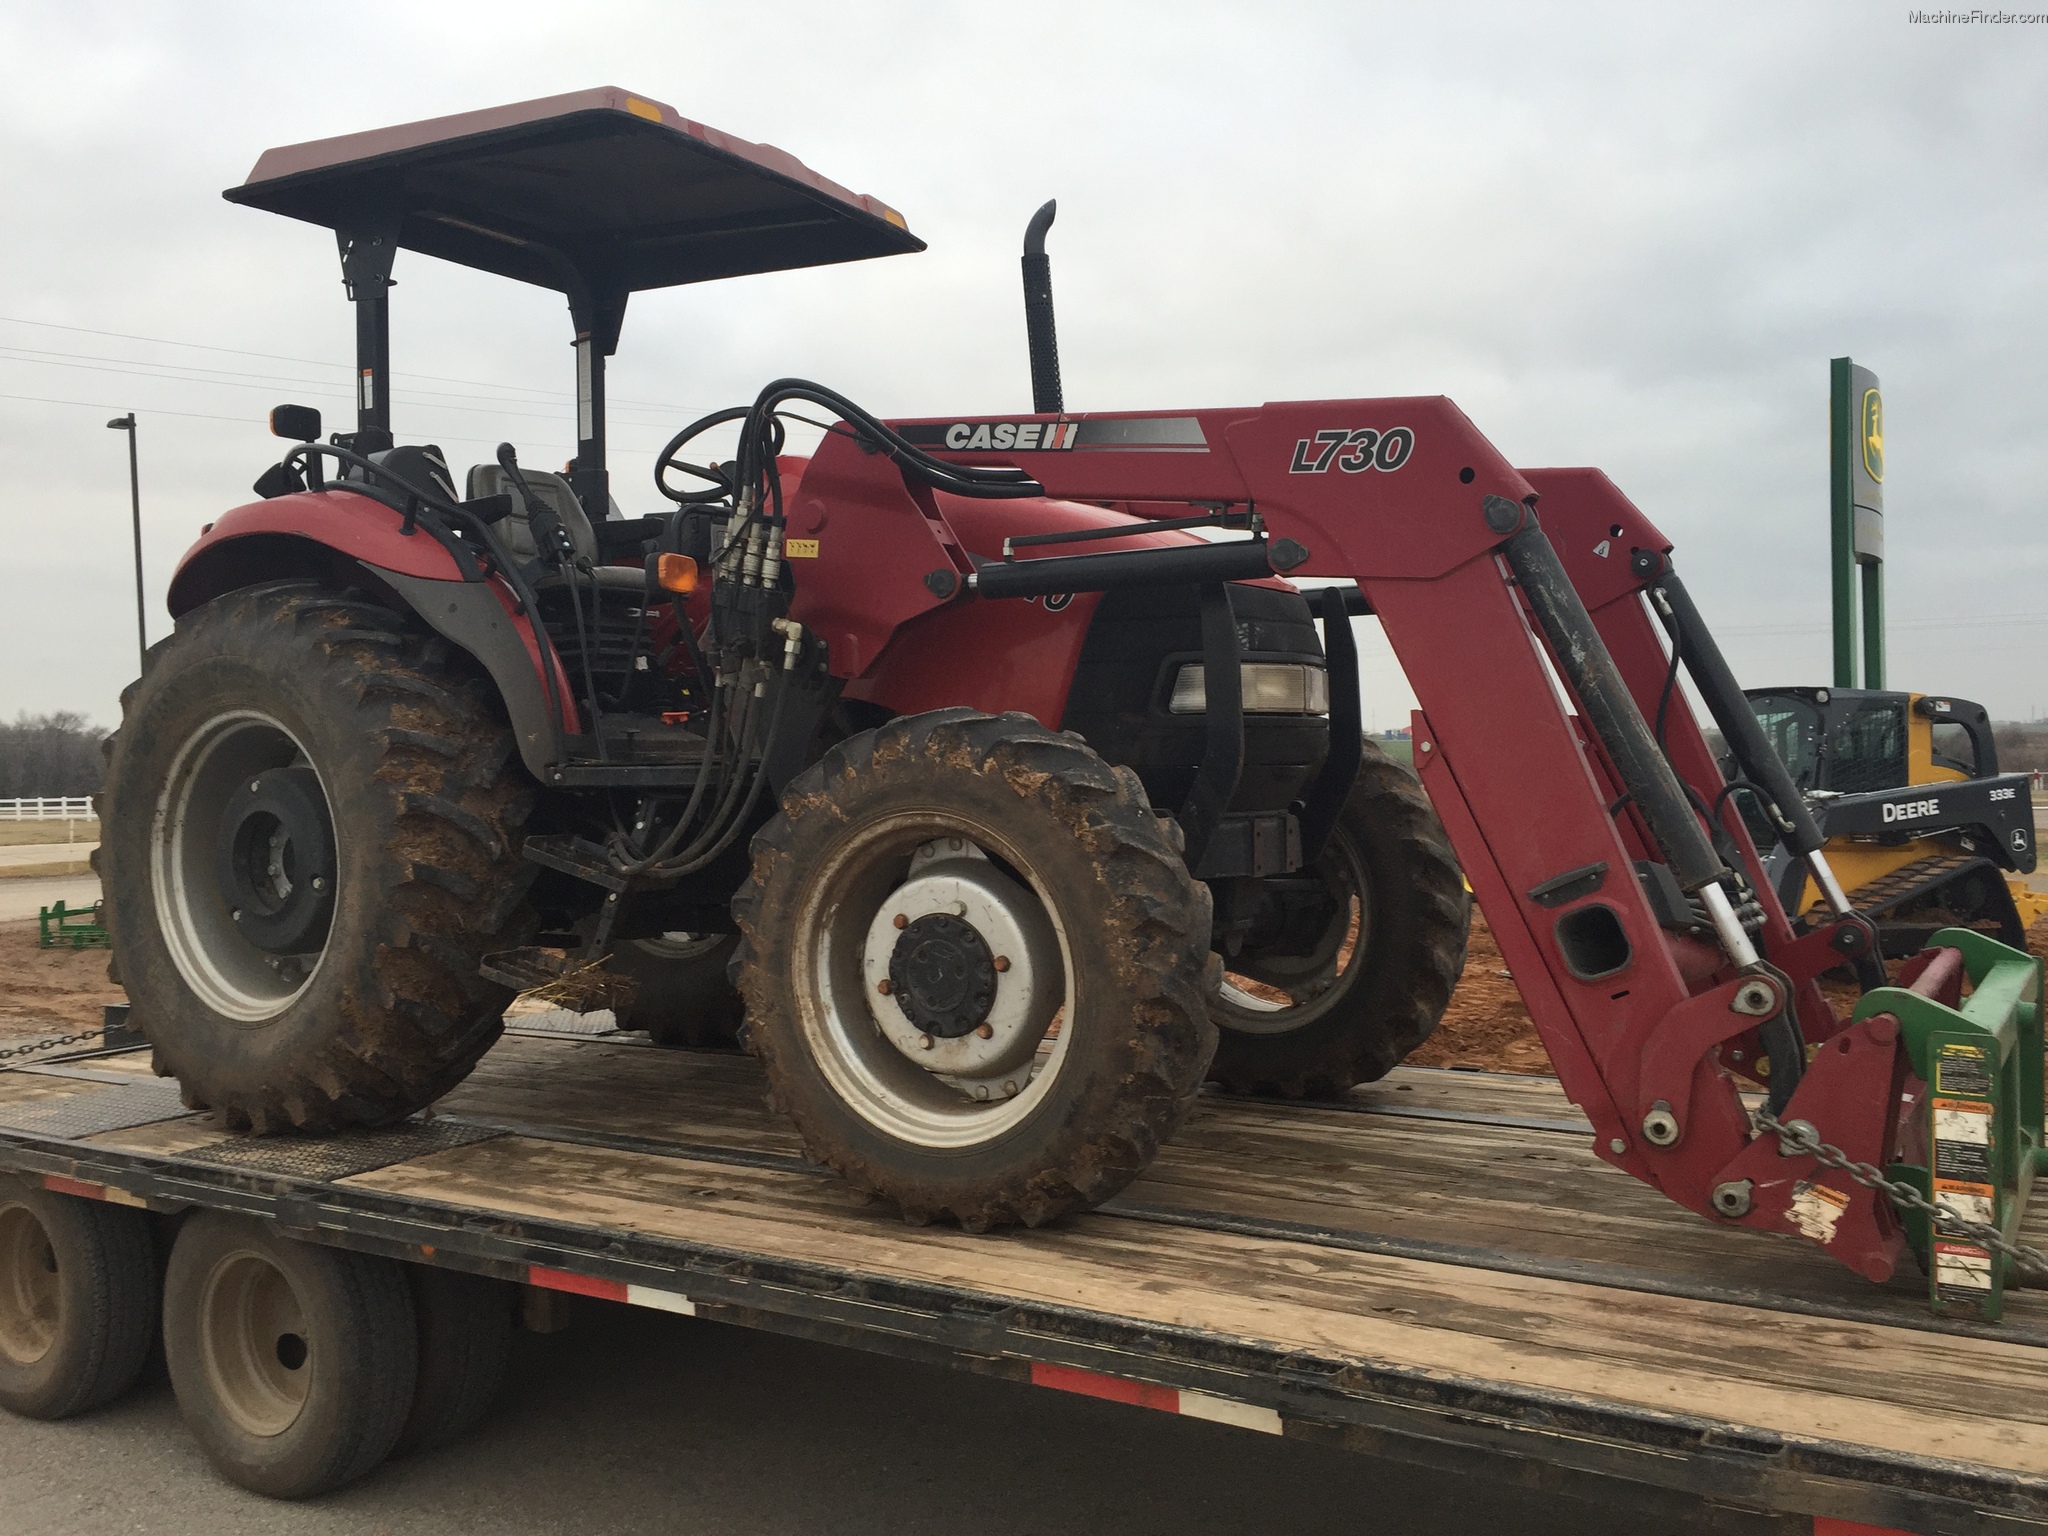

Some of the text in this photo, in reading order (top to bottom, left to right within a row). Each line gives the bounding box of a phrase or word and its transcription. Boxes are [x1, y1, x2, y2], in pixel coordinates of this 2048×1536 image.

[945, 423, 1042, 449] CASE
[1289, 426, 1415, 474] L730
[1989, 788, 2016, 801] 333E
[1882, 799, 1940, 823] DEERE
